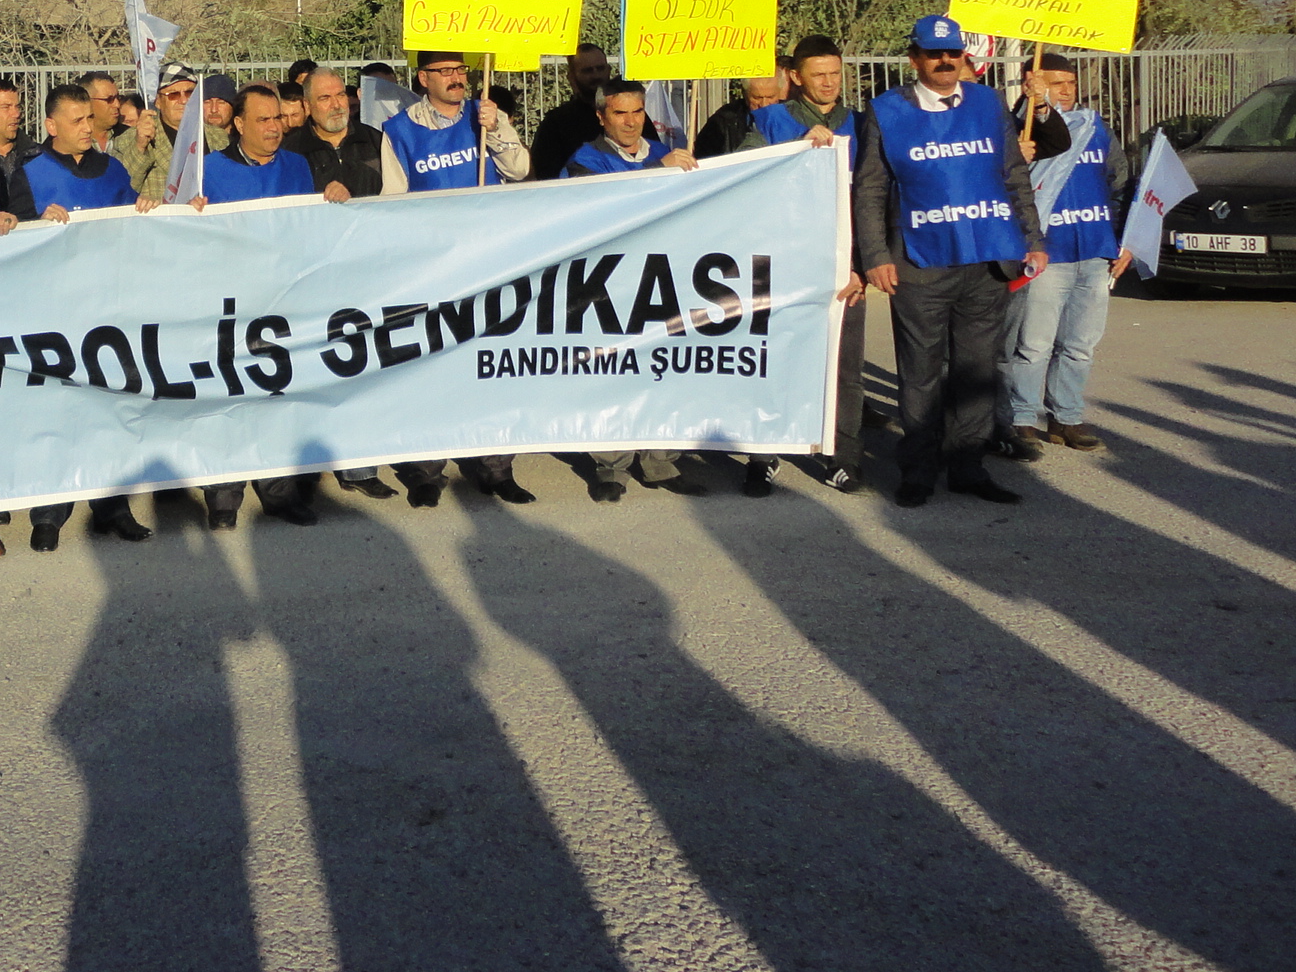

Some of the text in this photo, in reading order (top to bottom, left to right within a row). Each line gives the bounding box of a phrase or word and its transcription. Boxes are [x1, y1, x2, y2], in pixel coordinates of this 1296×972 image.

[410, 0, 471, 34] GERİ
[1020, 18, 1105, 42] OLMAK
[633, 25, 769, 58] İŞTEN ATILDIK
[909, 137, 994, 162] GÖREVLİ
[911, 200, 1012, 229] petrol-iş
[1186, 235, 1199, 249] 10
[1209, 236, 1231, 250] AHF
[1240, 237, 1257, 251] 38
[476, 340, 768, 382] BANDIRMA ŞUBESİ
